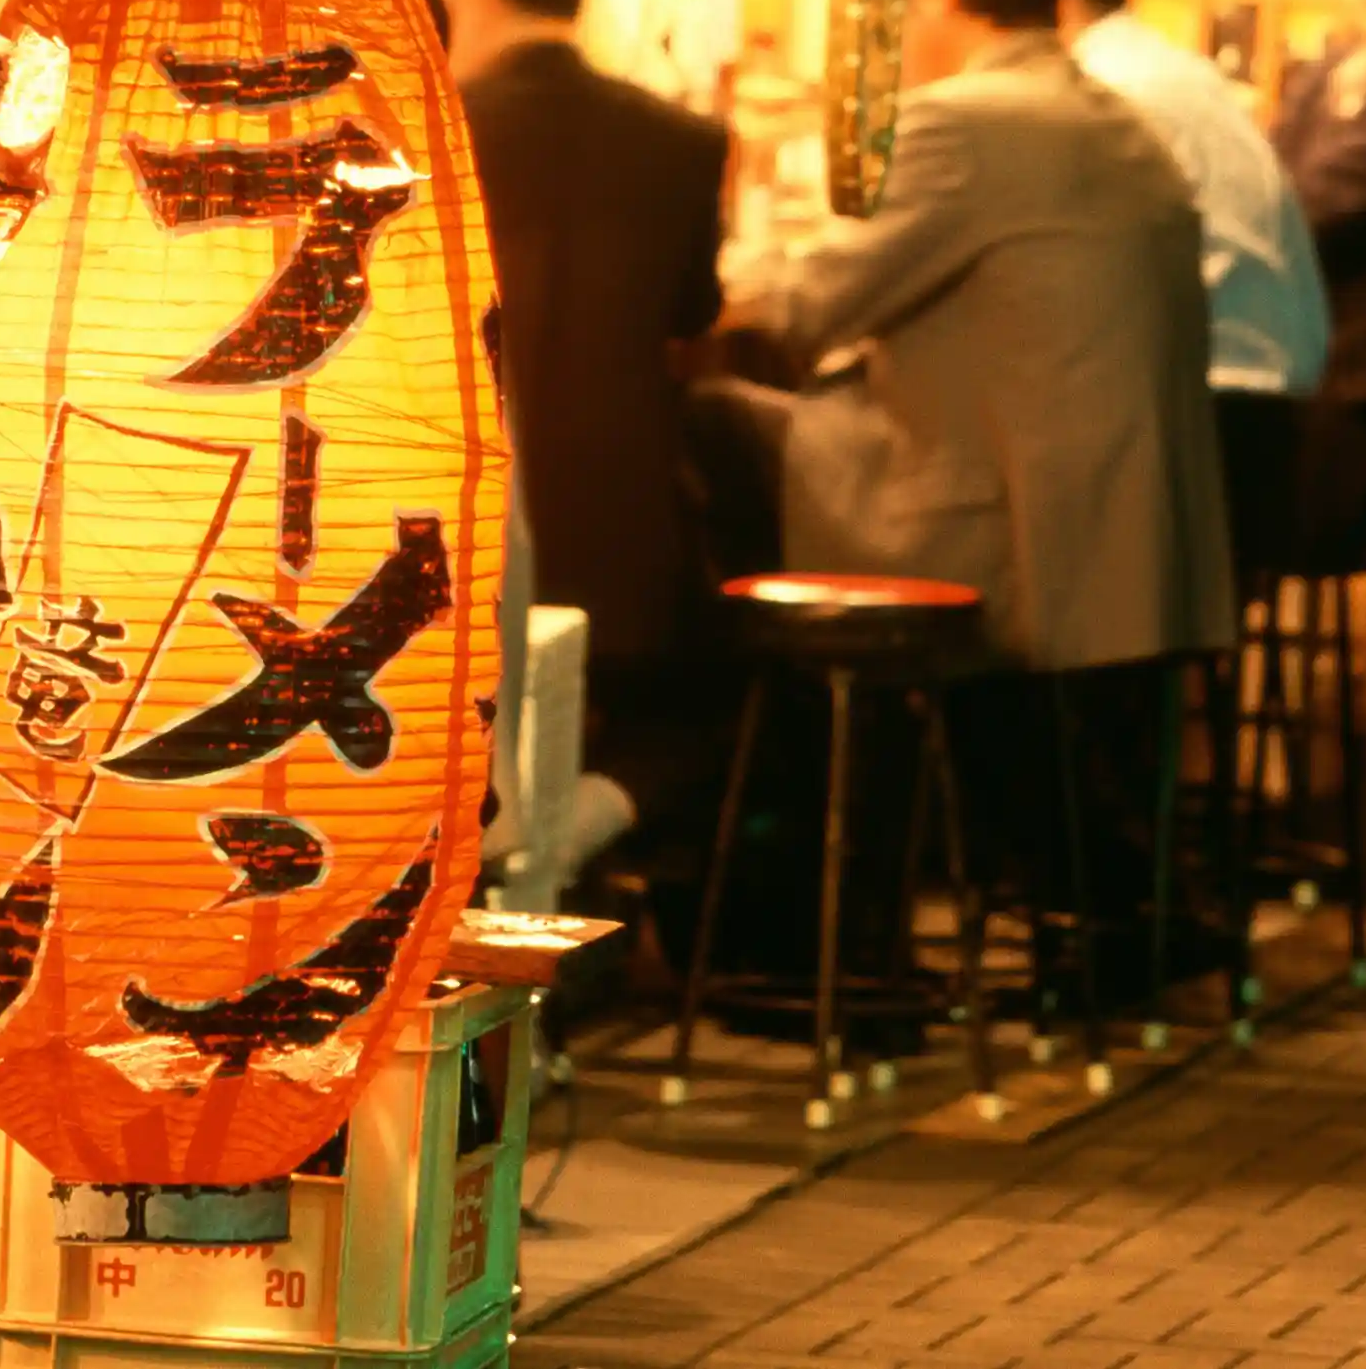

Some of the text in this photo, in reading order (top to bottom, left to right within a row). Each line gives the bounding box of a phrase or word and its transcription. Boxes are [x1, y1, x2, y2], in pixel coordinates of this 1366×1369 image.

[97, 43, 453, 1076] ラーメン
[97, 1257, 136, 1298] 中
[265, 1268, 306, 1308] 20
